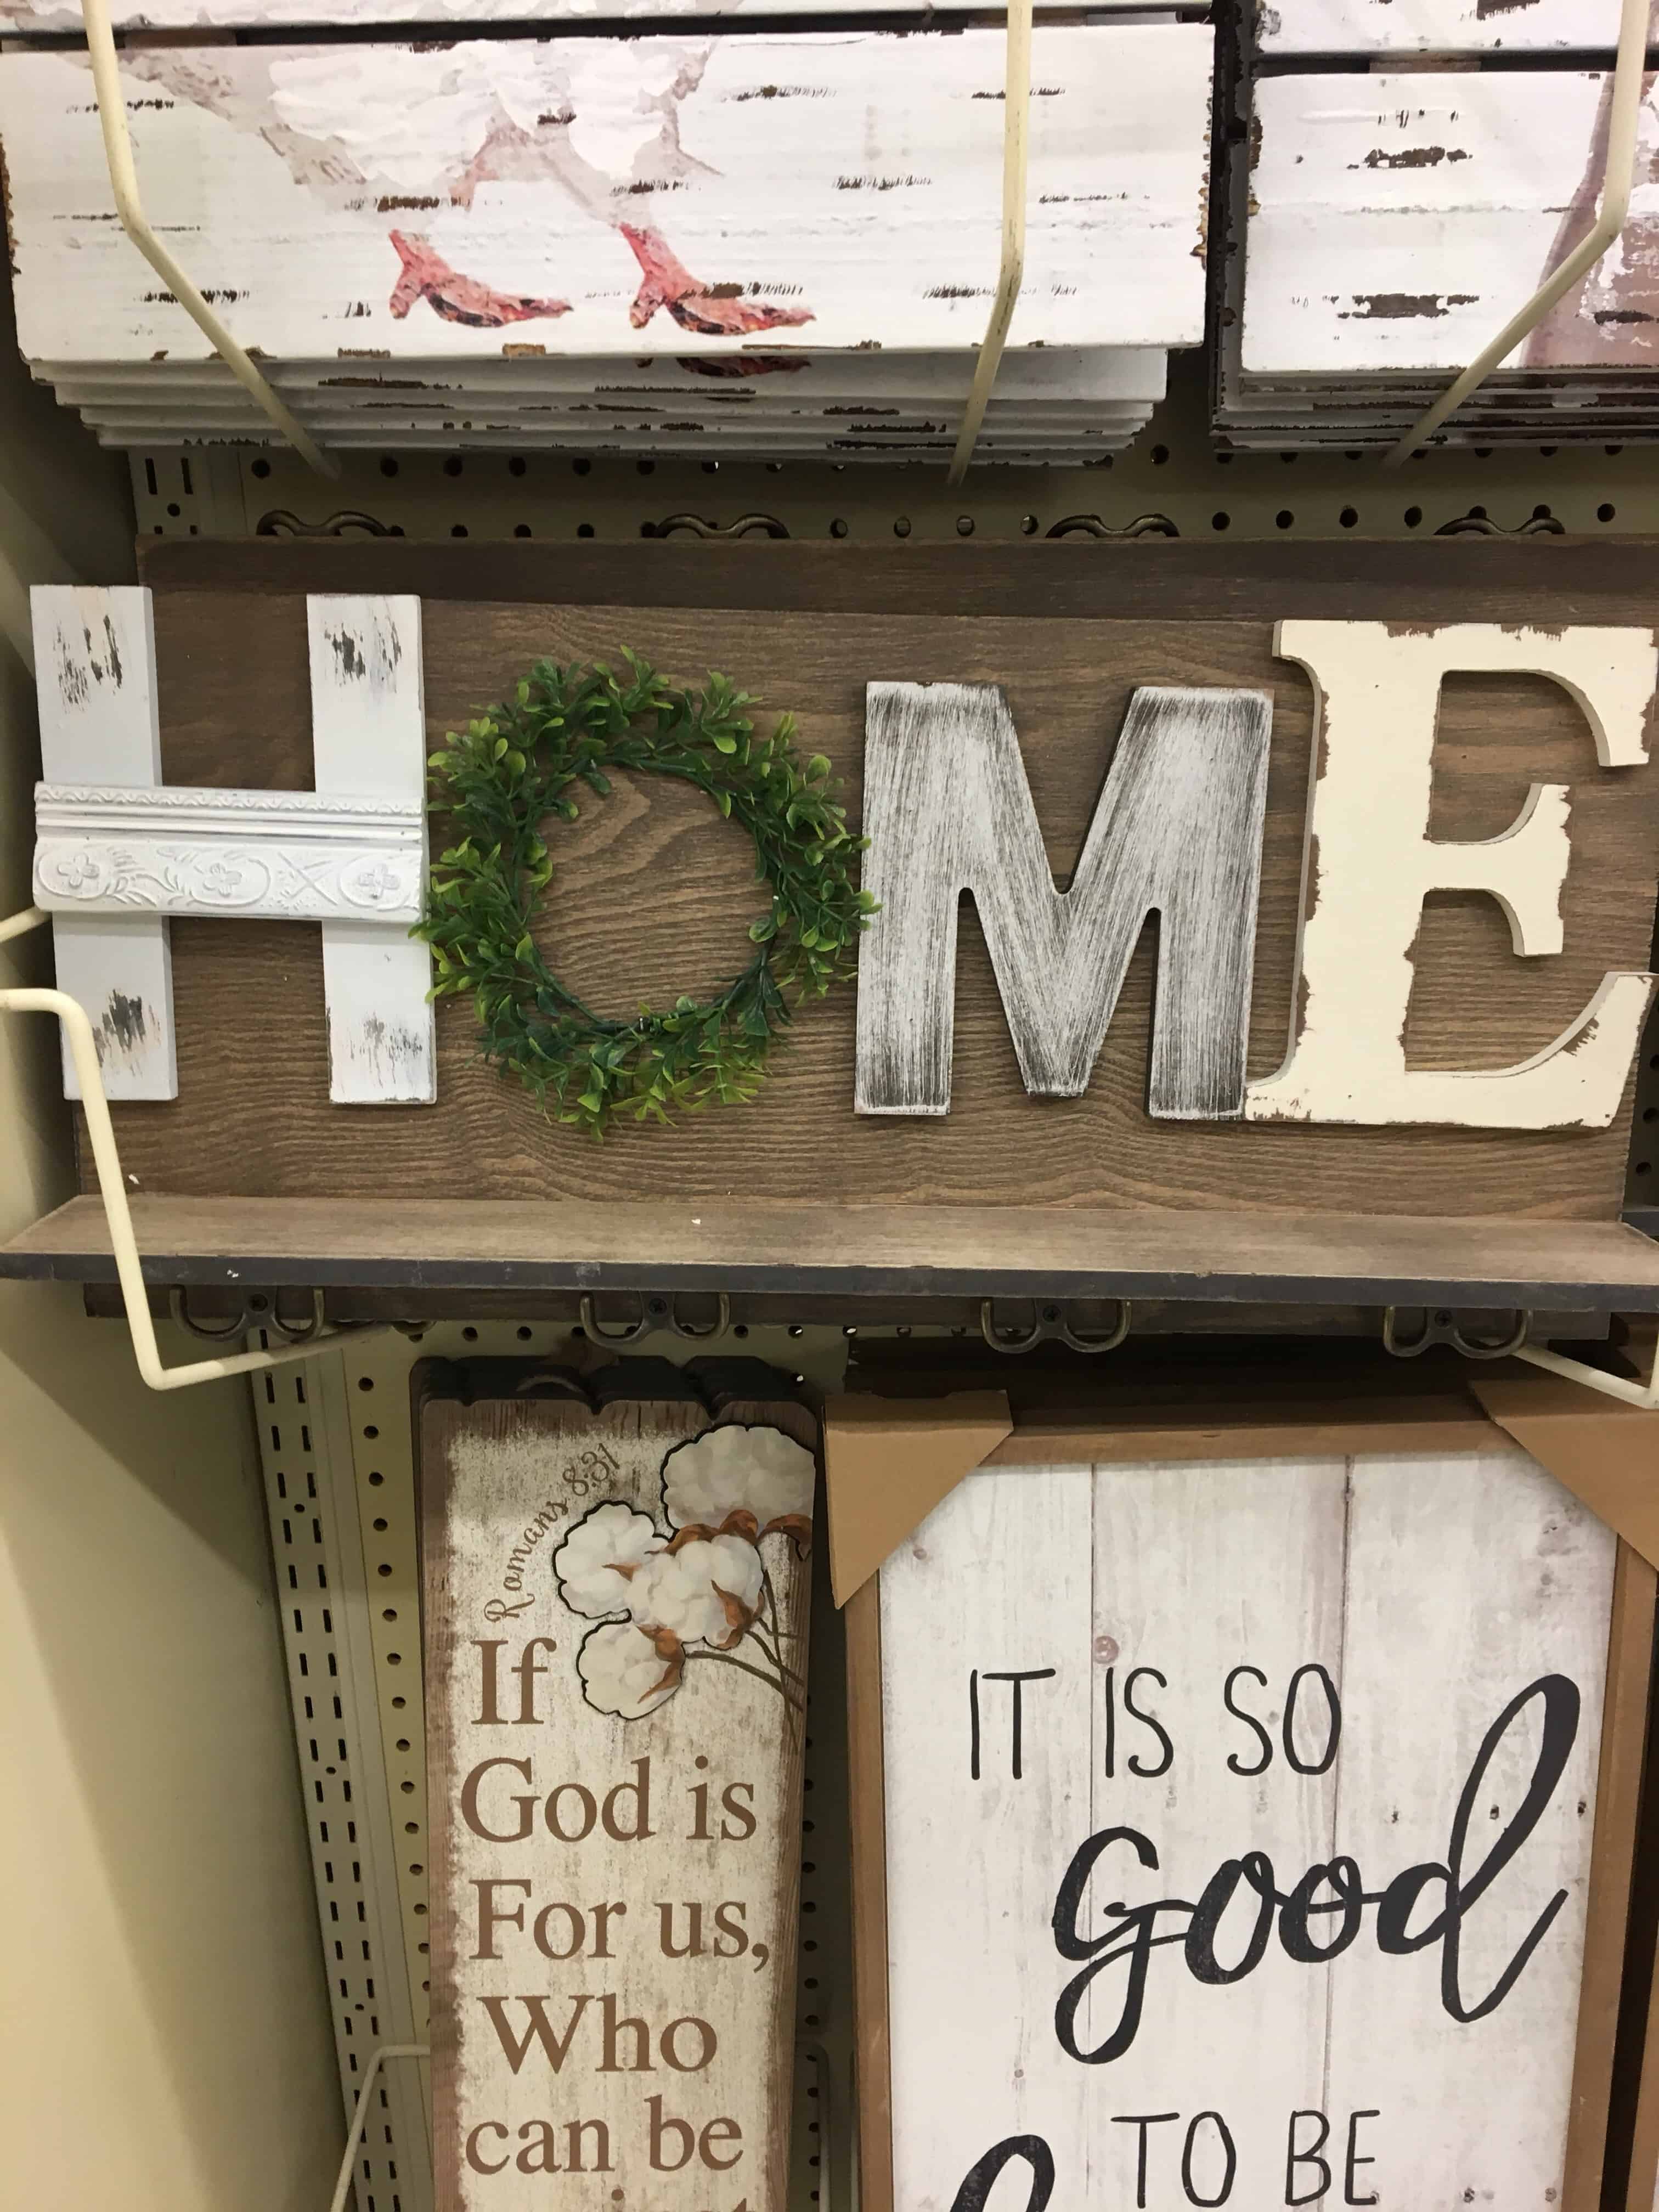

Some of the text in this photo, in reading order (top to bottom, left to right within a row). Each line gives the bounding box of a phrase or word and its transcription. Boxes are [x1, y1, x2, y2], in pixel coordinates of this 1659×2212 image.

[483, 1442, 620, 1623] Romans 8:31
[470, 1637, 557, 1725] If
[970, 1663, 1342, 1780] IT IS SO
[460, 1755, 758, 1843] God is
[469, 1879, 770, 1973] For us,
[476, 1993, 718, 2075] Who
[465, 2094, 744, 2175] can be
[1111, 2111, 1237, 2209] TO
[1285, 2110, 1380, 2206] BE
